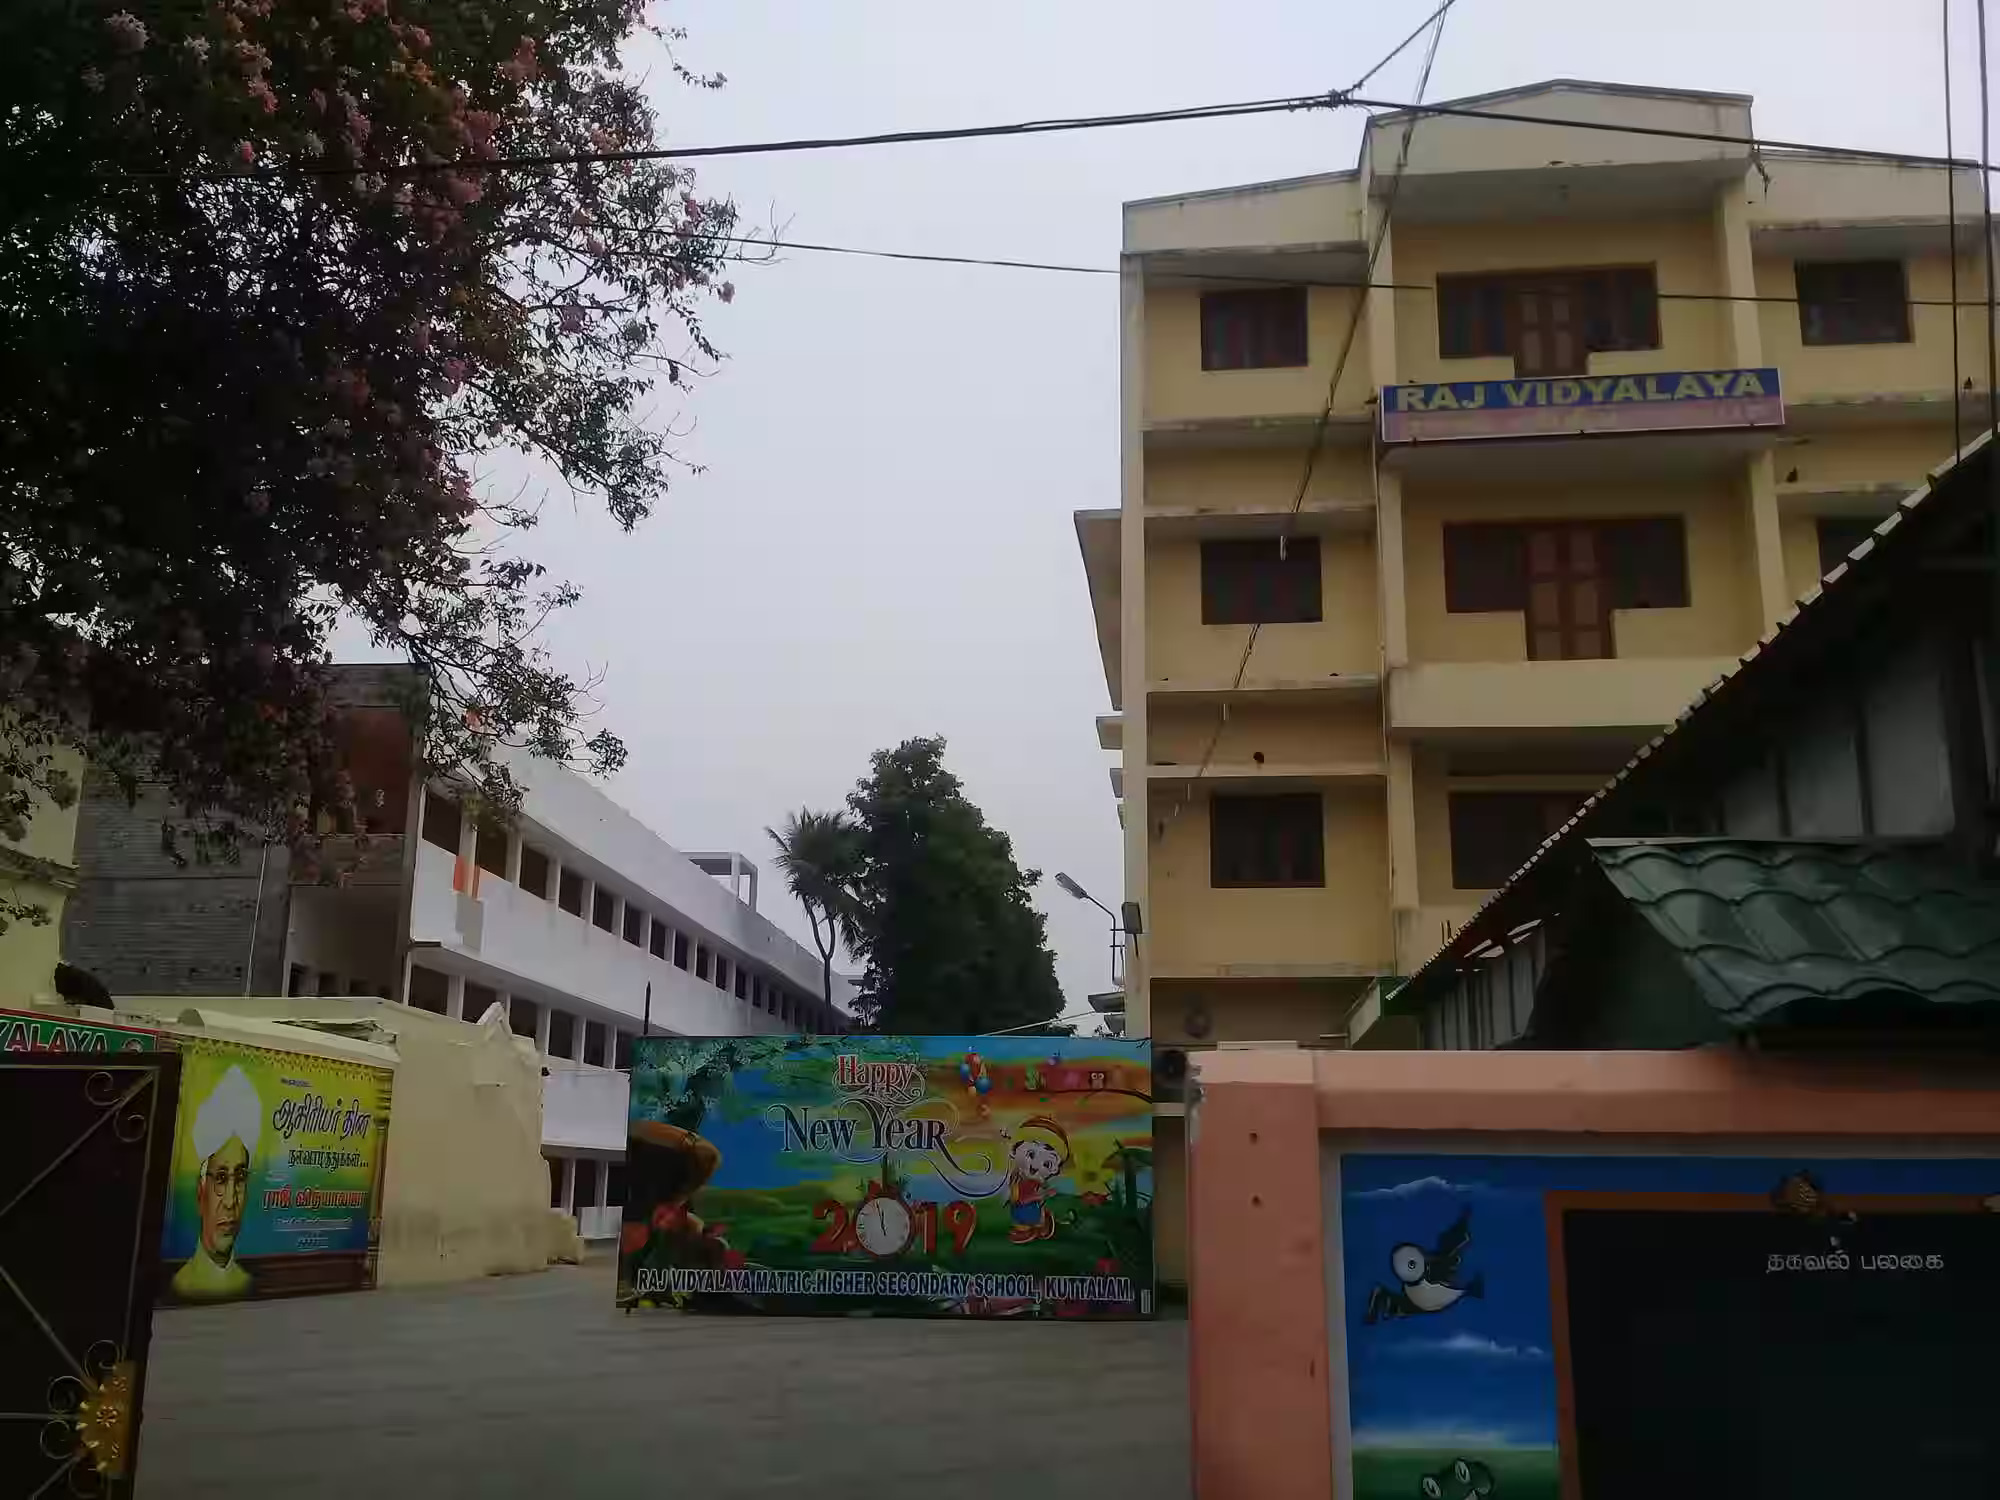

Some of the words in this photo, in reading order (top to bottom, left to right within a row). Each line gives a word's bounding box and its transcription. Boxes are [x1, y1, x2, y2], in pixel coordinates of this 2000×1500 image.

[1396, 386, 1486, 411] RAJ
[1504, 372, 1766, 407] VIDYALAYA
[836, 1054, 922, 1100] Happy
[273, 1093, 342, 1139] ஆசிரியர்
[340, 1099, 372, 1140] தின
[771, 1103, 858, 1153] New
[1766, 1250, 1850, 1273] தகவல்
[1861, 1254, 1944, 1271] பலகை
[637, 1268, 668, 1292] RAJ
[670, 1268, 752, 1293] VIDYALAYA
[878, 1271, 970, 1296] SECONDARY
[973, 1273, 1042, 1304] SCHOOL,
